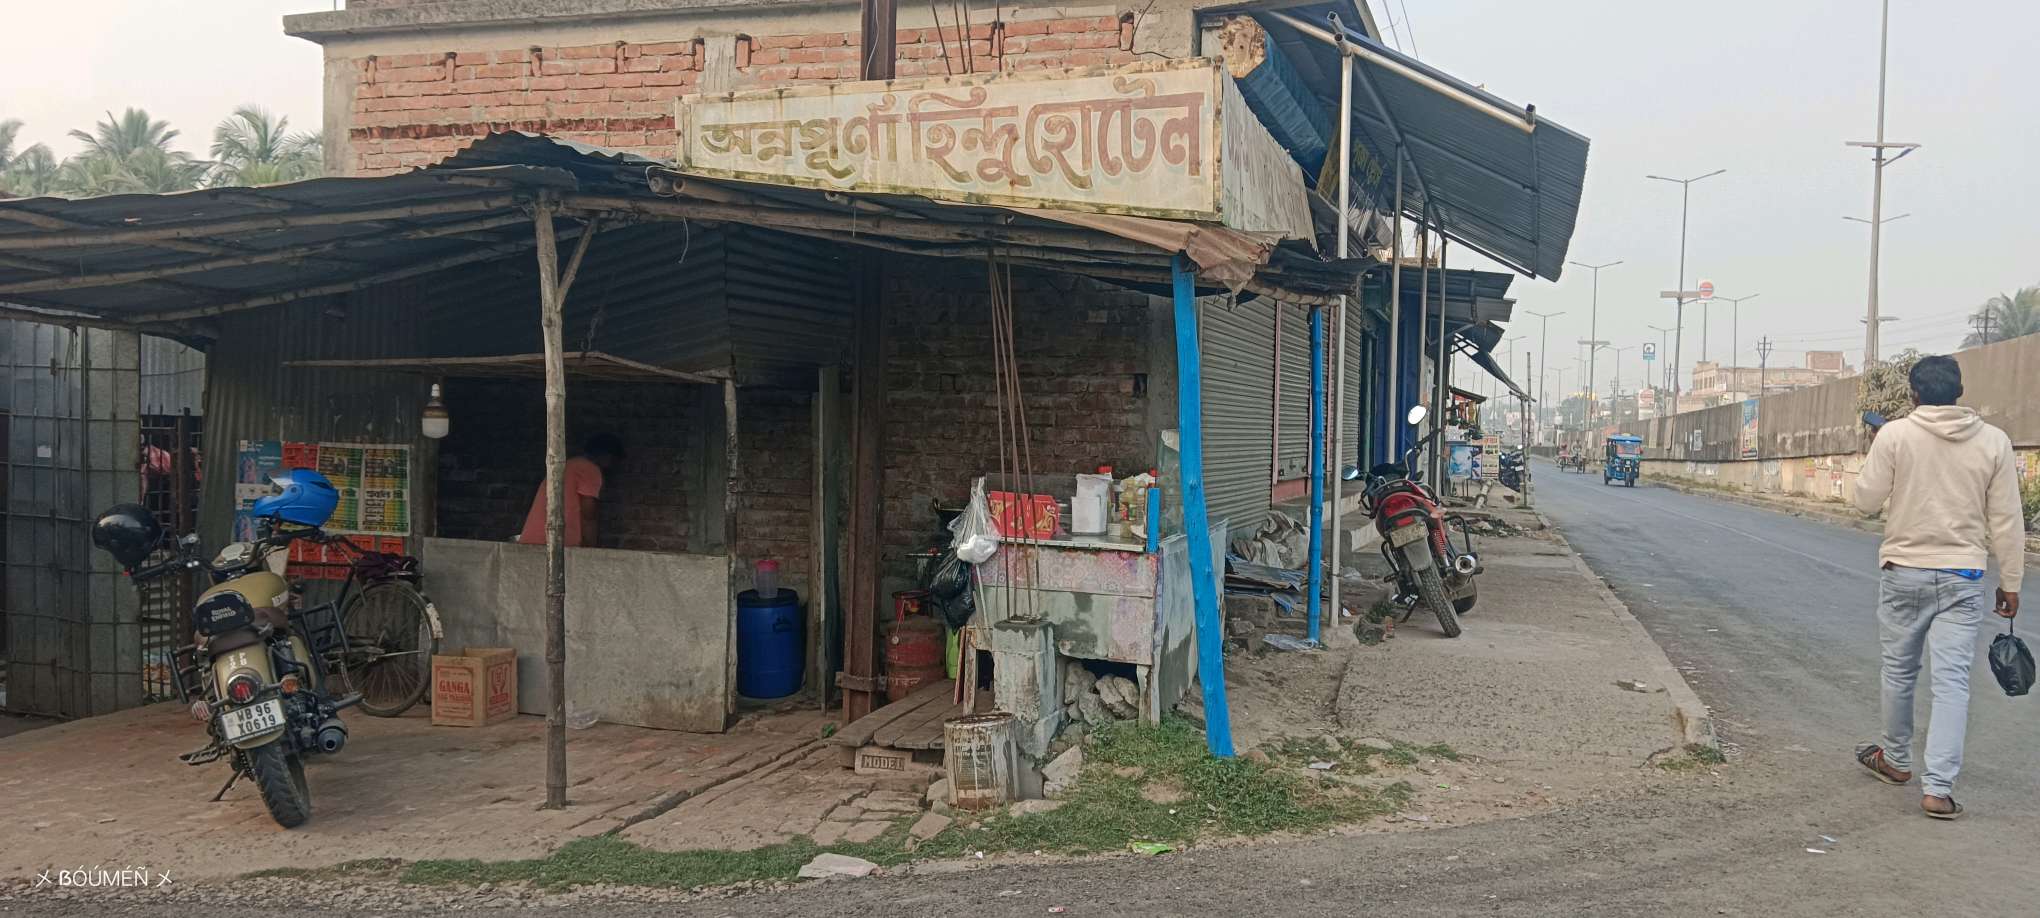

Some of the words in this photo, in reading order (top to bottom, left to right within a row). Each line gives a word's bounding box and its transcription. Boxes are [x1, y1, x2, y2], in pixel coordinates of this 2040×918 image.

[701, 94, 902, 179] অন্নপূর্ণা
[907, 86, 1032, 187] হিন্দু
[1025, 76, 1205, 189] হোটেল
[439, 679, 471, 694] GANGA
[236, 708, 253, 721] WB
[255, 703, 271, 717] 96
[863, 756, 904, 770] MODEL
